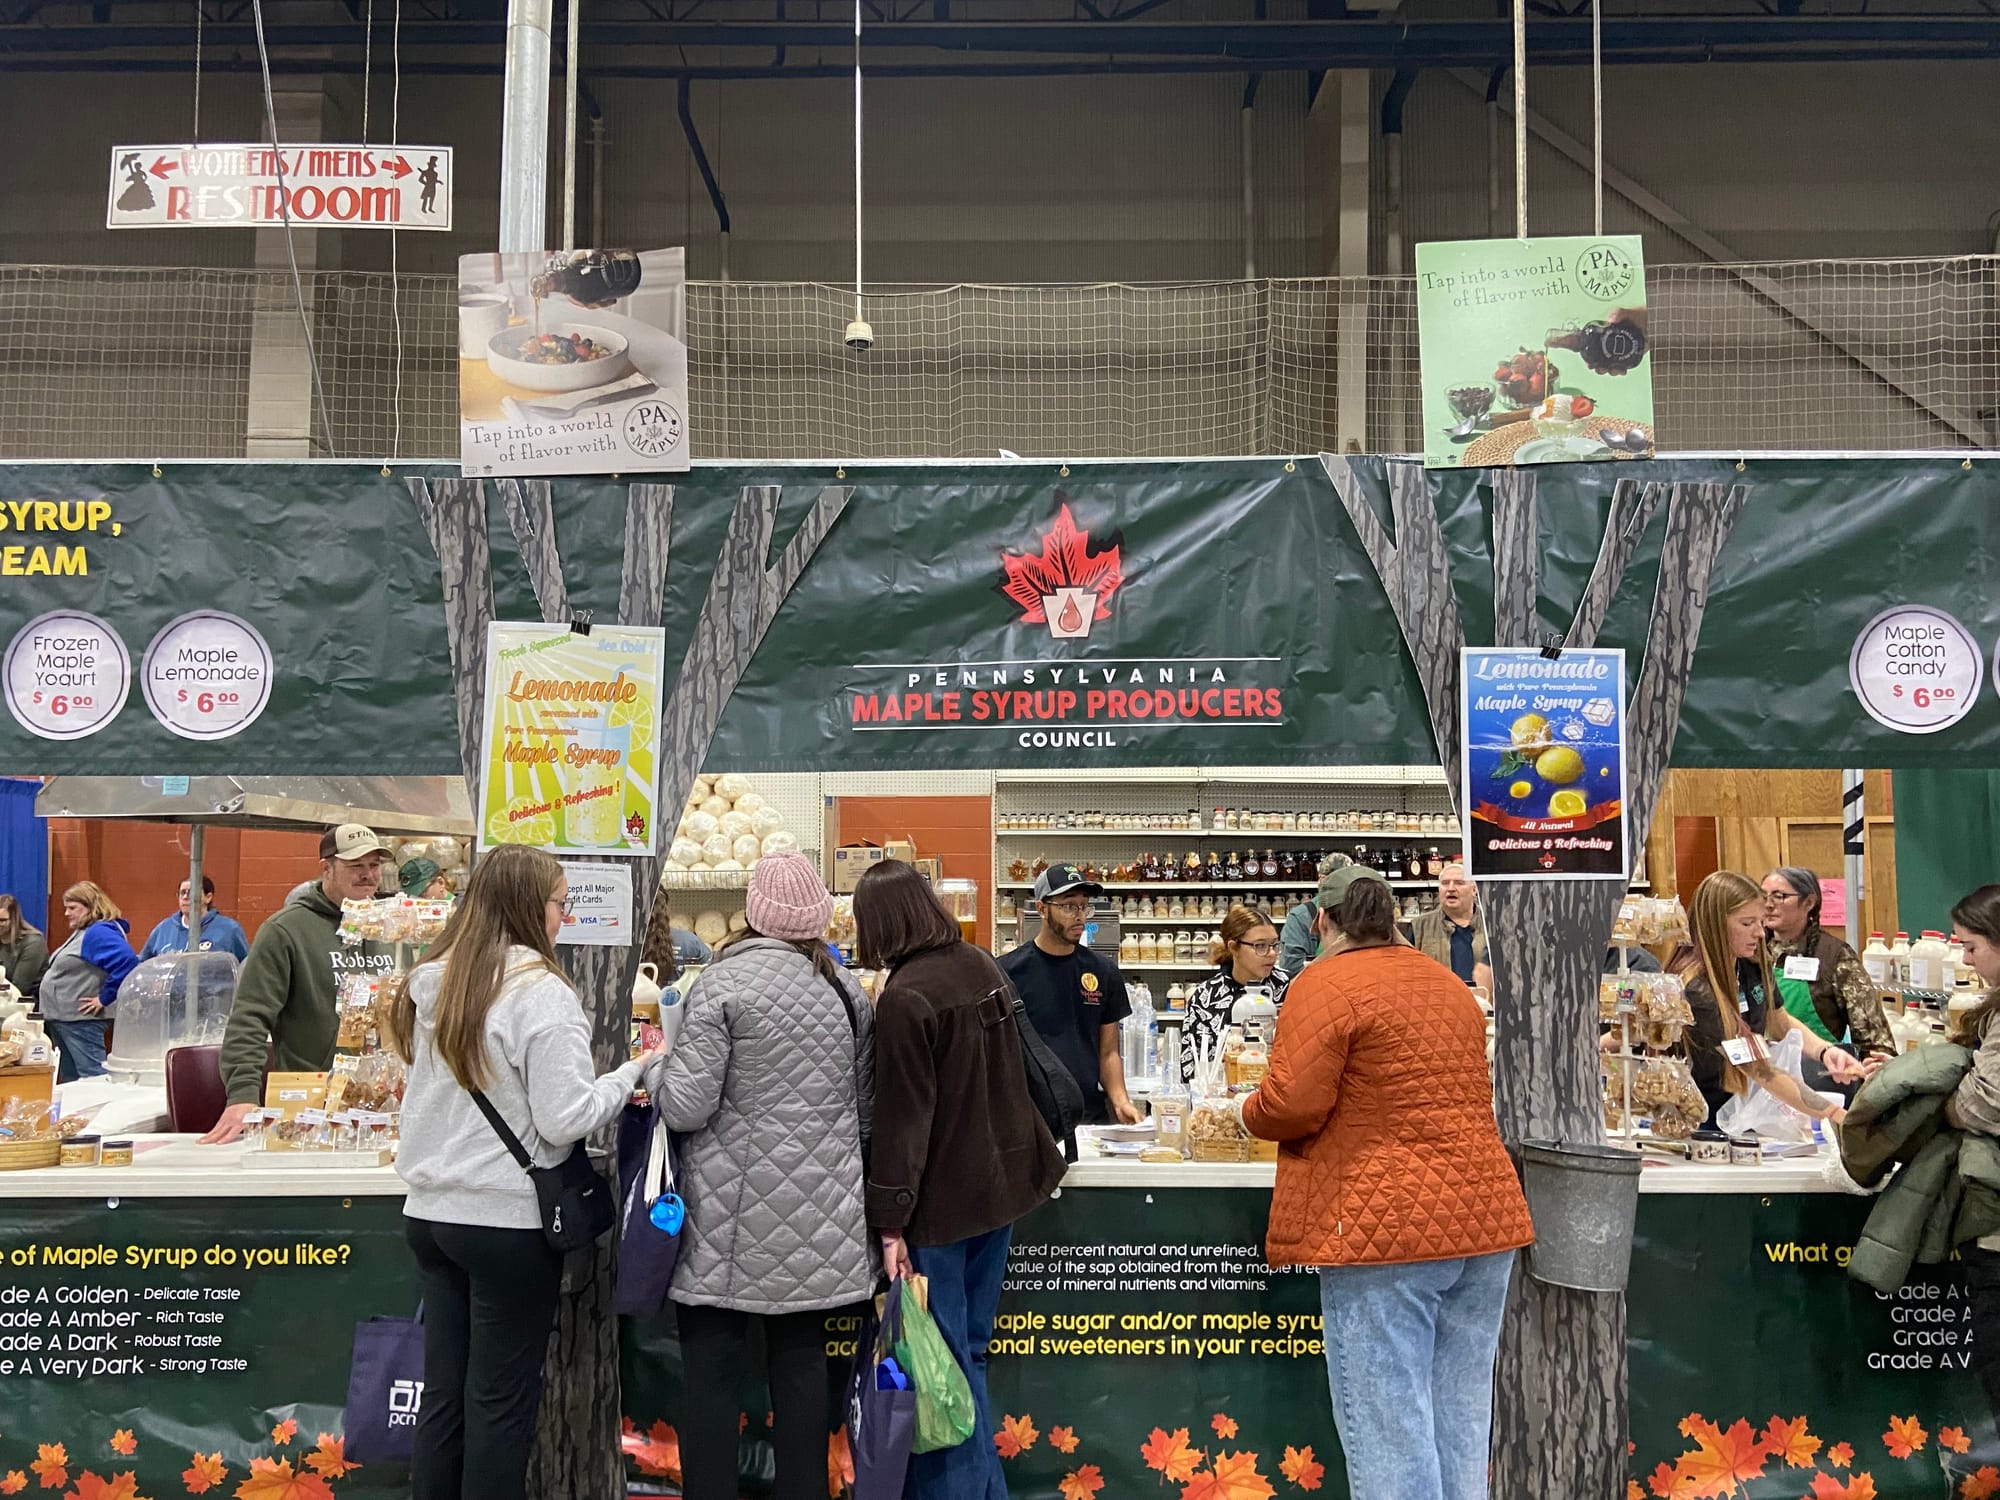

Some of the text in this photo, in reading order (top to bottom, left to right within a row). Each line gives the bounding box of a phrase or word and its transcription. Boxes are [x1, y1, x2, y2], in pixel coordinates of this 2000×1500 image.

[167, 185, 400, 222] RESTROOM
[1589, 249, 1620, 270] PA
[1422, 257, 1566, 293] Tap into a world
[1585, 271, 1632, 297] MAPLE
[1453, 278, 1570, 308] of flavor with
[637, 405, 668, 426] PA
[469, 413, 614, 448] Tap into a world
[499, 434, 618, 462] of flavor with
[632, 428, 679, 454] MAPLE
[0, 546, 88, 576] EAM
[34, 636, 100, 651] Frozen
[1885, 625, 1945, 643] Maple
[177, 647, 239, 669] Maple
[1886, 643, 1946, 658] Cotton
[36, 653, 96, 672] Maple
[1473, 656, 1609, 681] Lemonade
[1885, 660, 1947, 678] Candy
[34, 671, 97, 687] Yogurt
[154, 664, 260, 681] Lemonade
[907, 667, 1226, 688] PENNSYLVANIA
[505, 670, 637, 704] Lemonade
[852, 688, 1283, 722] MAPLE SYRUP PRODUCERS
[1474, 694, 1583, 713] Maple Syrup
[1018, 731, 1117, 748] COUNCIL
[502, 740, 621, 770] Maple Syrup
[509, 802, 552, 822] Delicious
[563, 784, 614, 806] Refreshing
[1538, 820, 1574, 830] Natural
[1488, 837, 1614, 851] Delicious & Refreshing
[567, 884, 615, 894] cept All Major
[582, 895, 603, 904] Cards
[328, 951, 395, 968] Robson
[11, 1244, 36, 1266] of
[42, 1244, 118, 1269] Maple
[125, 1245, 198, 1269] Syrup
[204, 1244, 237, 1266] do
[242, 1248, 289, 1270] you
[295, 1243, 351, 1265] like?
[1009, 1243, 1260, 1258] dred percent natural and unrefined,
[1764, 1242, 1828, 1263] What
[1007, 1260, 1045, 1273] value
[1048, 1260, 1062, 1273] of
[1065, 1260, 1087, 1273] the
[1089, 1262, 1116, 1276] sap
[1118, 1260, 1181, 1273] obtained
[1184, 1260, 1217, 1274] from
[1221, 1260, 1243, 1273] the
[1001, 1277, 1269, 1291] ource of mineral nutrients and vitamins.
[1946, 1284, 1959, 1300] A
[0, 1285, 30, 1304] de
[34, 1287, 49, 1304] A
[55, 1285, 129, 1304] Golden
[144, 1287, 200, 1300] Delicate
[203, 1287, 241, 1300] Taste
[0, 1309, 42, 1327] ade
[48, 1310, 61, 1327] A
[66, 1309, 142, 1327] Amber
[156, 1311, 184, 1323] Rich
[187, 1311, 224, 1323] Taste
[993, 1311, 1046, 1334] aple
[1052, 1313, 1115, 1335] sugar
[1120, 1311, 1197, 1331] and/or
[1202, 1311, 1272, 1334] maple
[1277, 1313, 1324, 1334] syru
[1891, 1305, 1956, 1323] Grade
[0, 1332, 42, 1351] ade
[47, 1334, 62, 1351] A
[68, 1332, 118, 1351] Dark
[134, 1334, 182, 1347] Robust
[184, 1334, 222, 1347] Taste
[1893, 1328, 1958, 1346] Grade
[988, 1335, 1035, 1355] onal
[1040, 1336, 1166, 1355] sweeteners
[1170, 1335, 1190, 1355] in
[1194, 1338, 1246, 1360] your
[19, 1358, 33, 1375] A
[39, 1357, 88, 1379] Very
[92, 1355, 144, 1375] Dark
[159, 1358, 207, 1374] Strong
[210, 1358, 248, 1371] Taste
[1867, 1352, 1933, 1369] Grade
[1939, 1353, 1953, 1369] A
[388, 1413, 417, 1428] pcn
